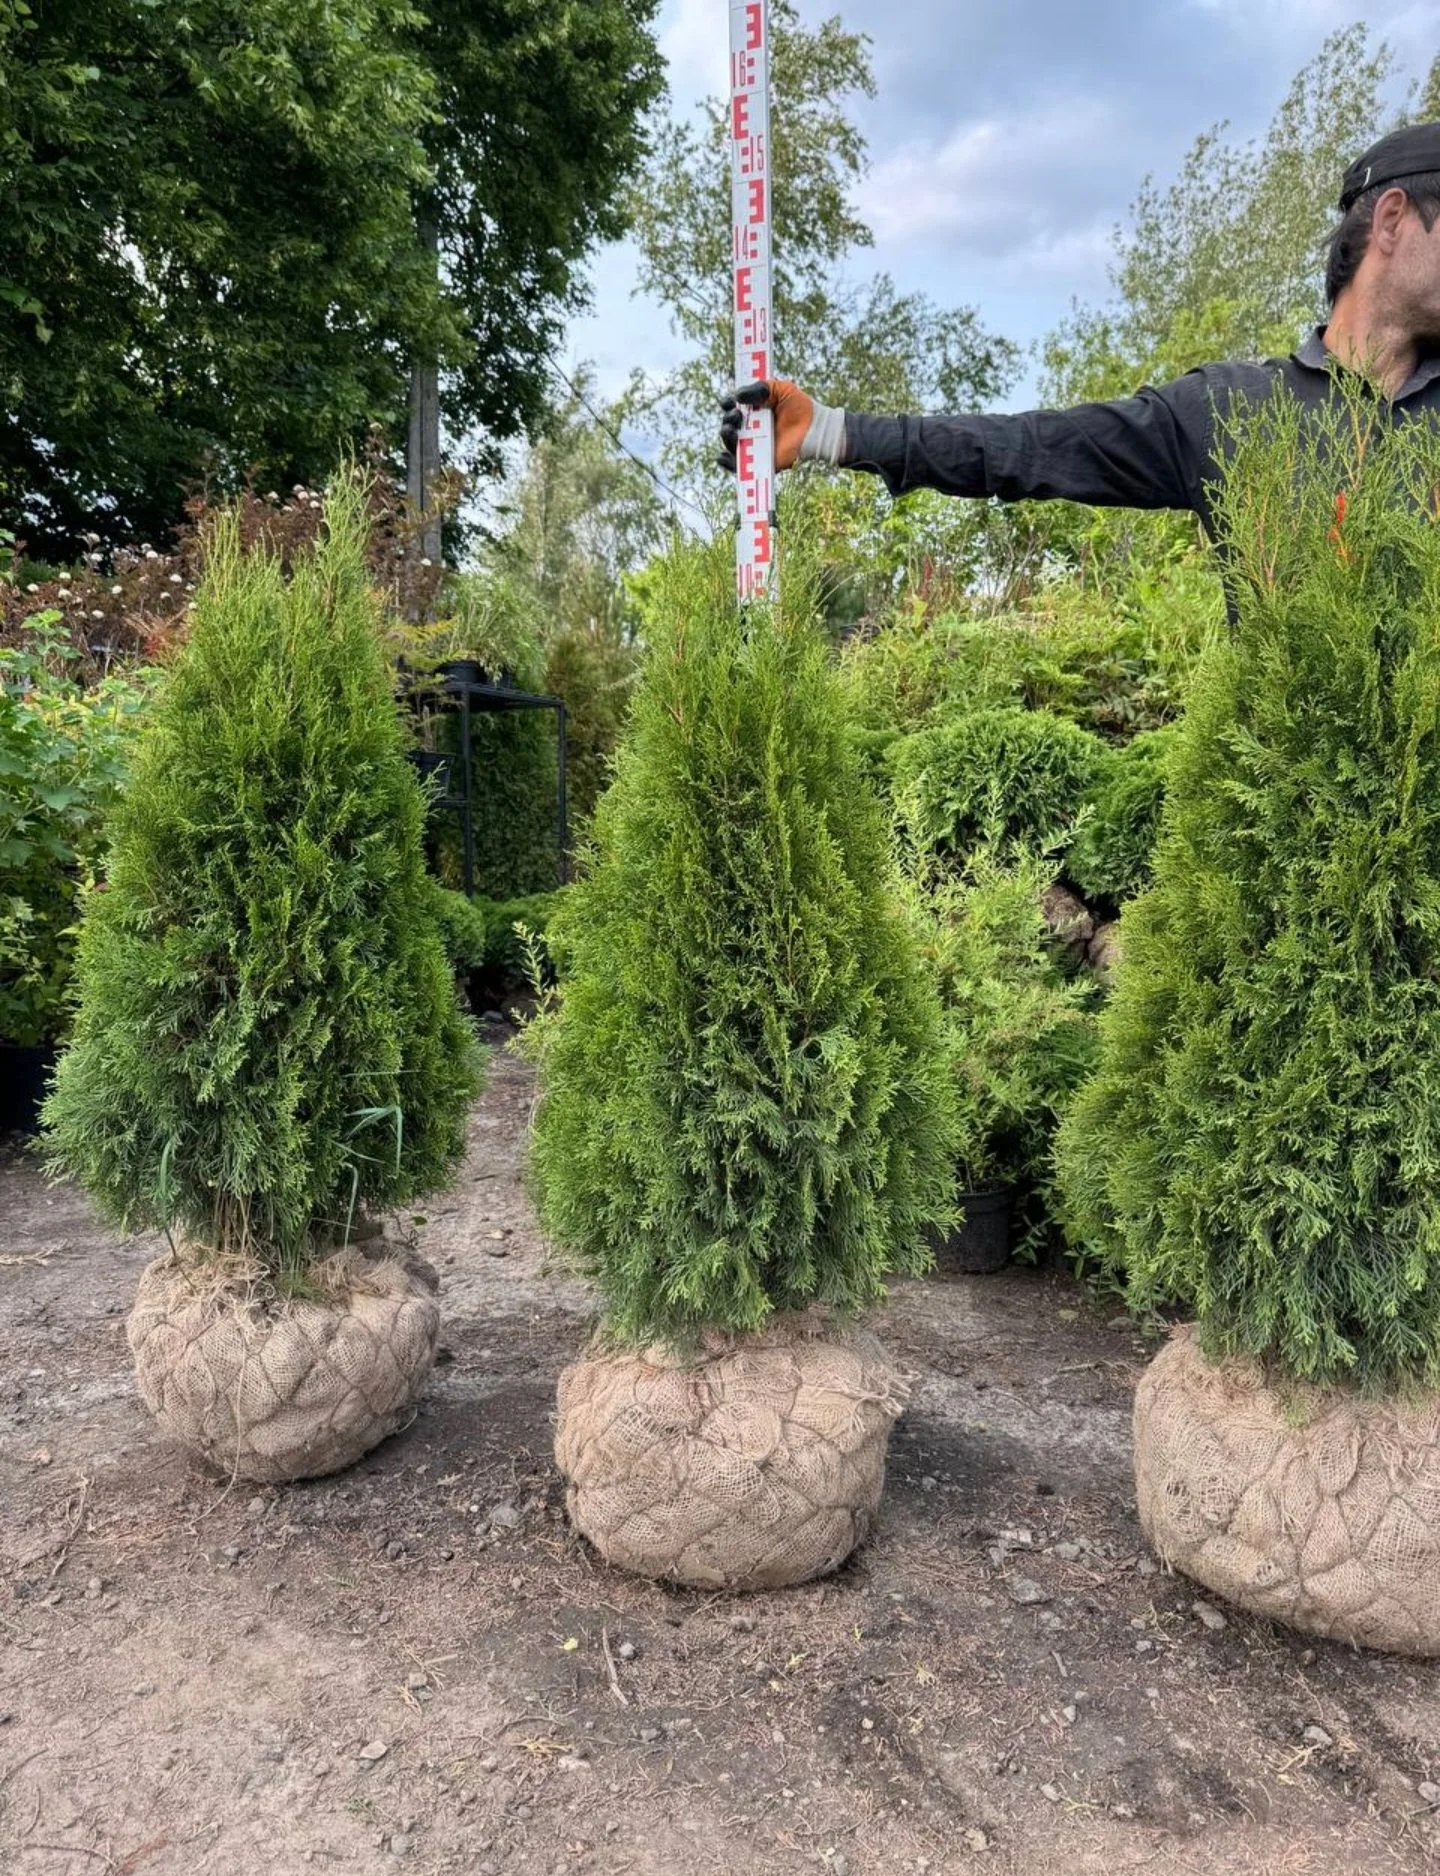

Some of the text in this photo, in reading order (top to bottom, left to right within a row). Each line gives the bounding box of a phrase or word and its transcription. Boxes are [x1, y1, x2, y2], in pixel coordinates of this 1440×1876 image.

[732, 50, 746, 88] 16
[750, 134, 764, 172] 15
[735, 224, 748, 260] 14
[753, 307, 767, 344] 13
[756, 478, 769, 513] 11
[739, 563, 752, 598] 10
